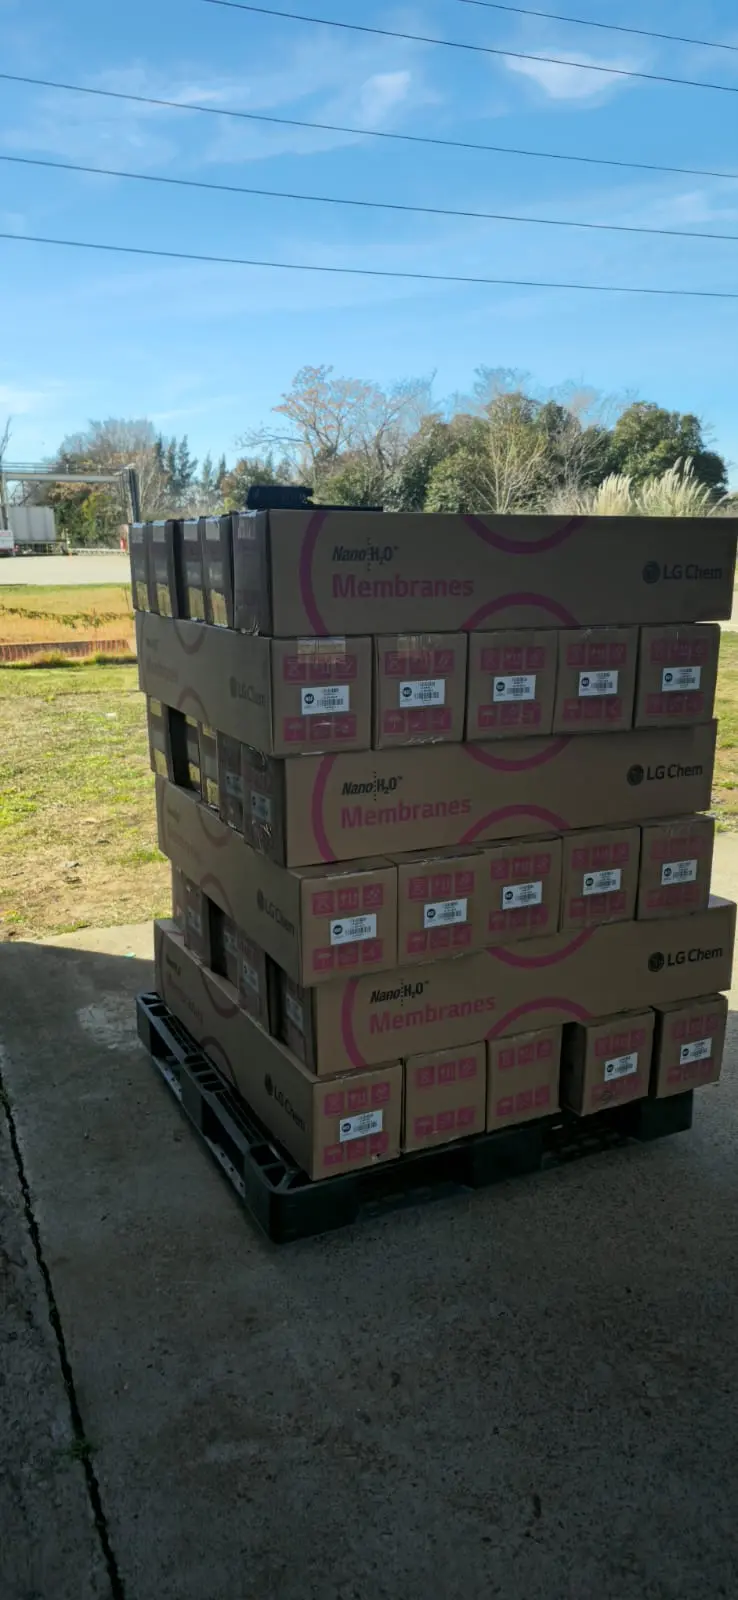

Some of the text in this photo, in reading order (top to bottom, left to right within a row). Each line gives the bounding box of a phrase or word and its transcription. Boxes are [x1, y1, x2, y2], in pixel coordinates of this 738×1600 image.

[663, 563, 722, 580] LG Chem
[332, 573, 475, 598] Membranes
[646, 763, 704, 780] LG Chem
[340, 798, 472, 829] Membranes
[667, 947, 724, 968] LG Chem
[370, 996, 497, 1035] Membranes
